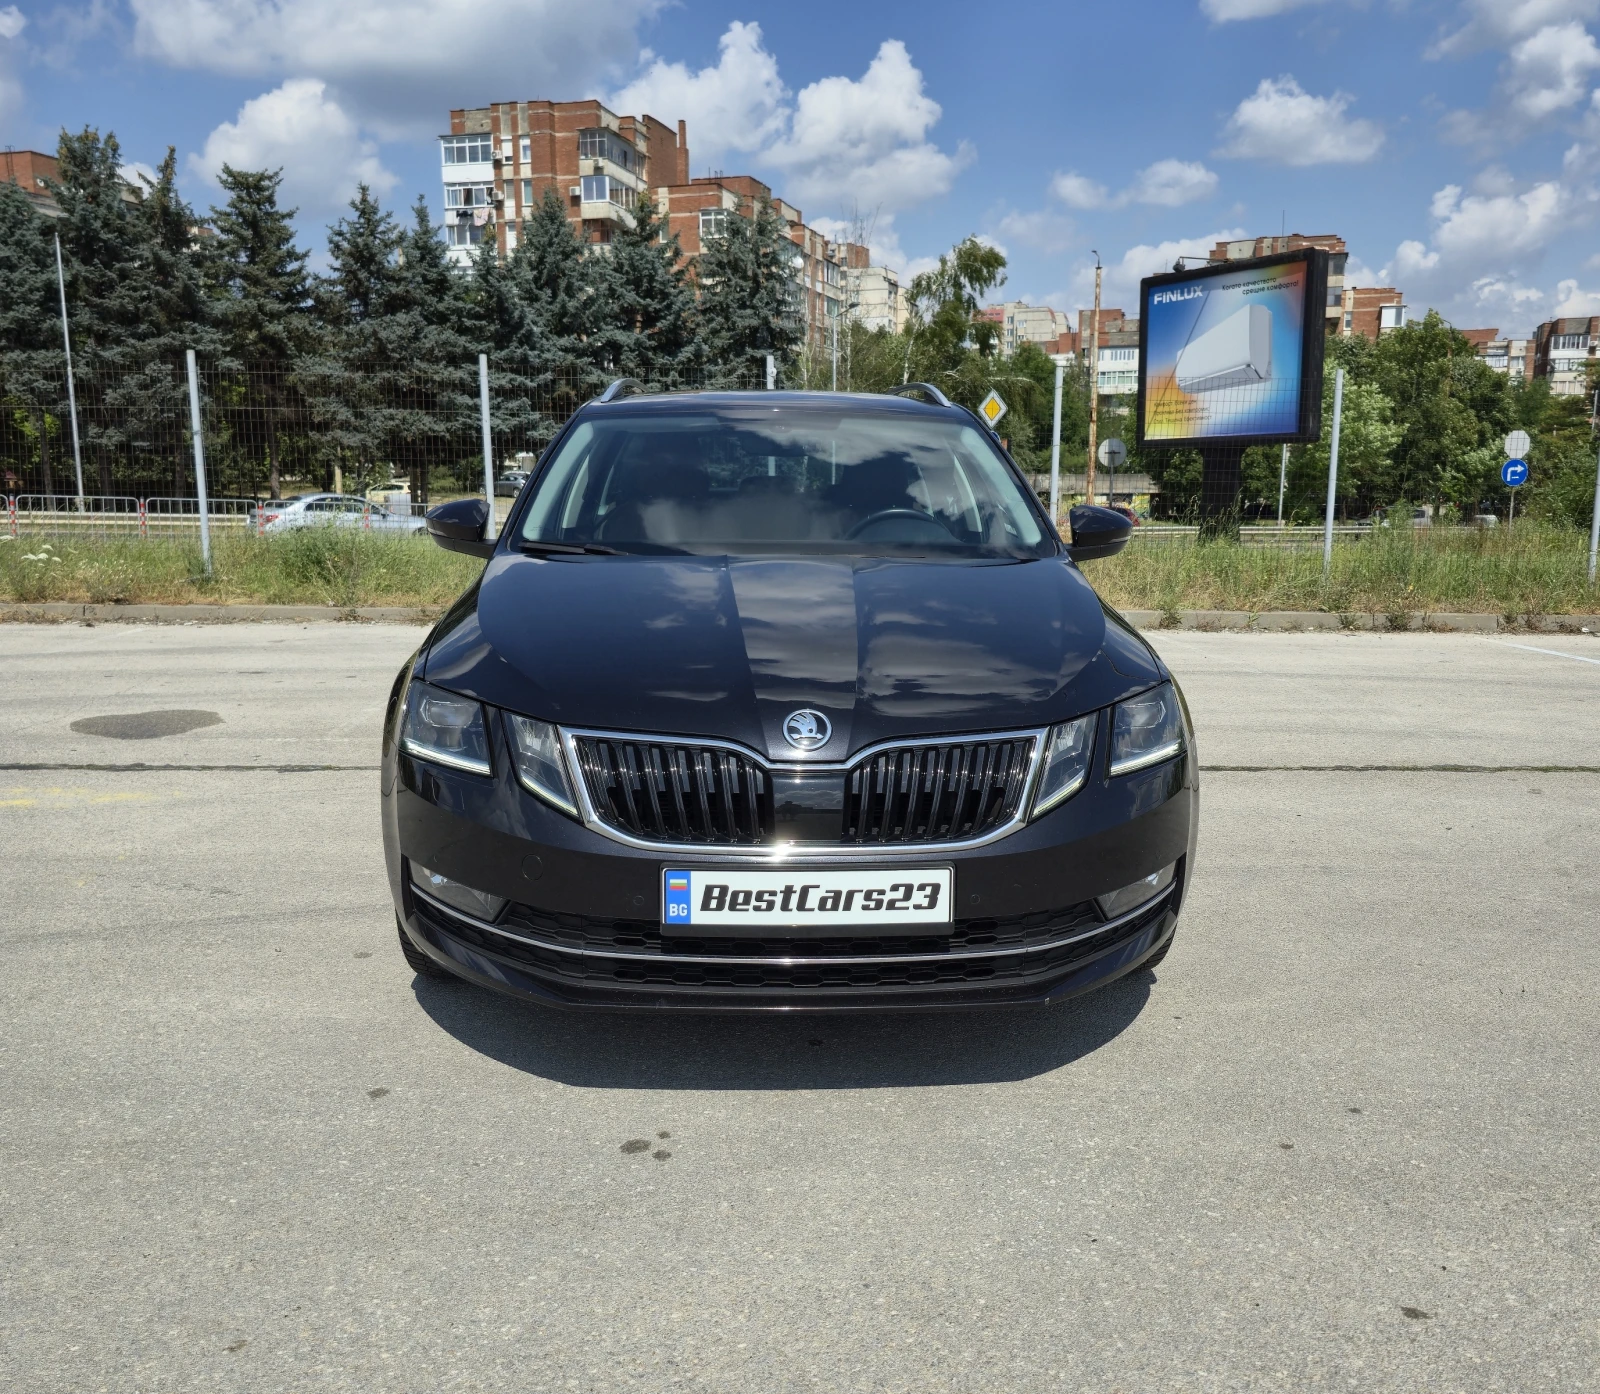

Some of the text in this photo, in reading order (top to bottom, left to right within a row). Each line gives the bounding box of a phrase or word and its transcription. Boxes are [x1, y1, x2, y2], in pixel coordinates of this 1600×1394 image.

[1222, 277, 1277, 291] Когато качеството
[1242, 280, 1299, 295] срещне комфорта!
[1153, 285, 1203, 305] FINLUX
[699, 883, 942, 912] BestCars23
[669, 903, 688, 917] BG
